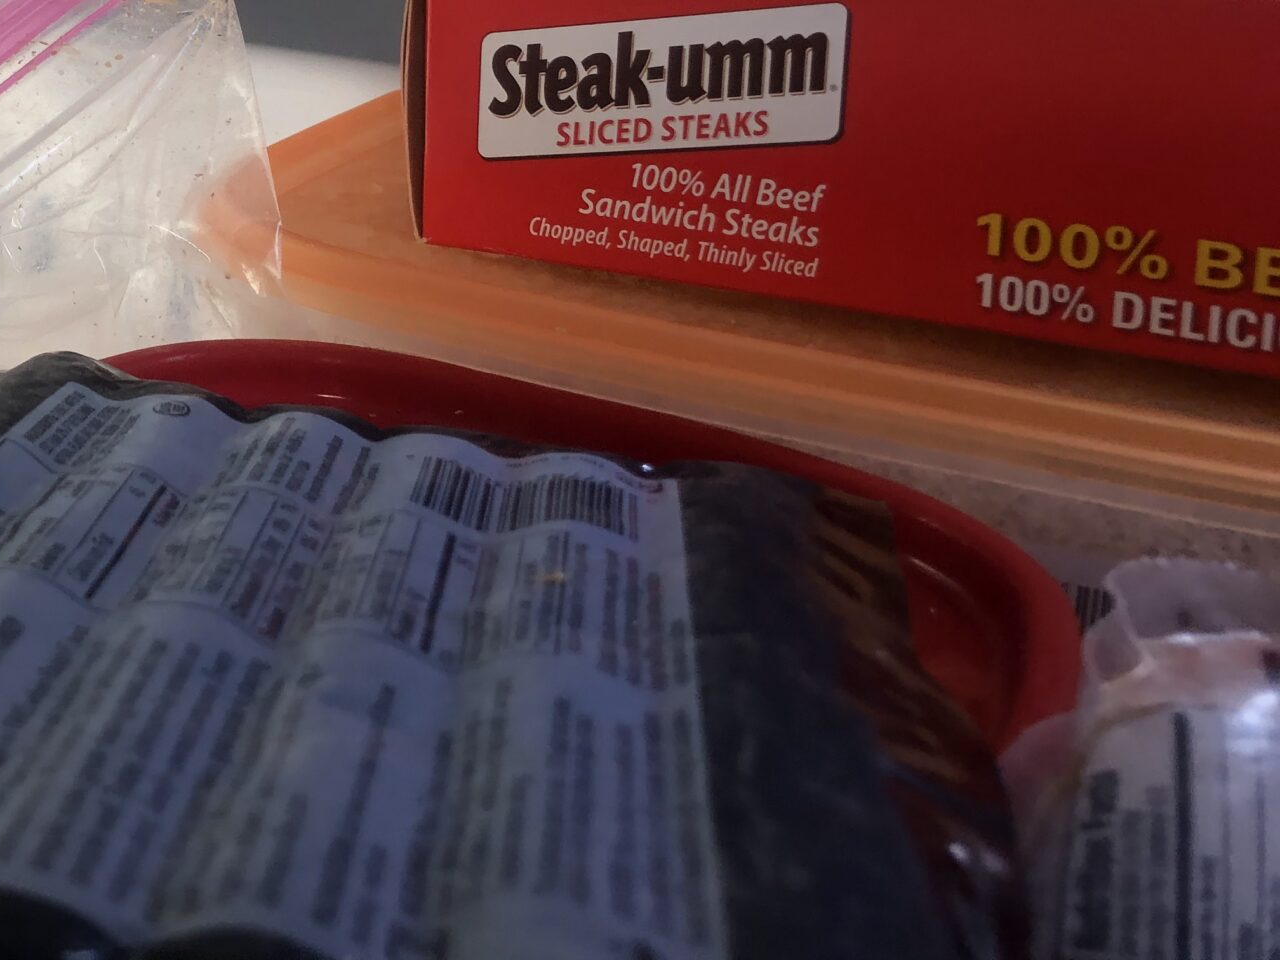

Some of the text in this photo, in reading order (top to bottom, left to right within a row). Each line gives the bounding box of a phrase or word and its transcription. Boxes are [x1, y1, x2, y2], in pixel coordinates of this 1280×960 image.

[487, 30, 831, 118] Steak-umm
[556, 110, 771, 148] SLICED STEAKS
[578, 188, 821, 248] Sandwich Steaks
[631, 162, 827, 213] 100% All Beef
[528, 216, 821, 278] Chopped, Shaped, Thinly Sliced
[976, 212, 1169, 281] 100%
[976, 272, 1280, 353] 100% DELICI
